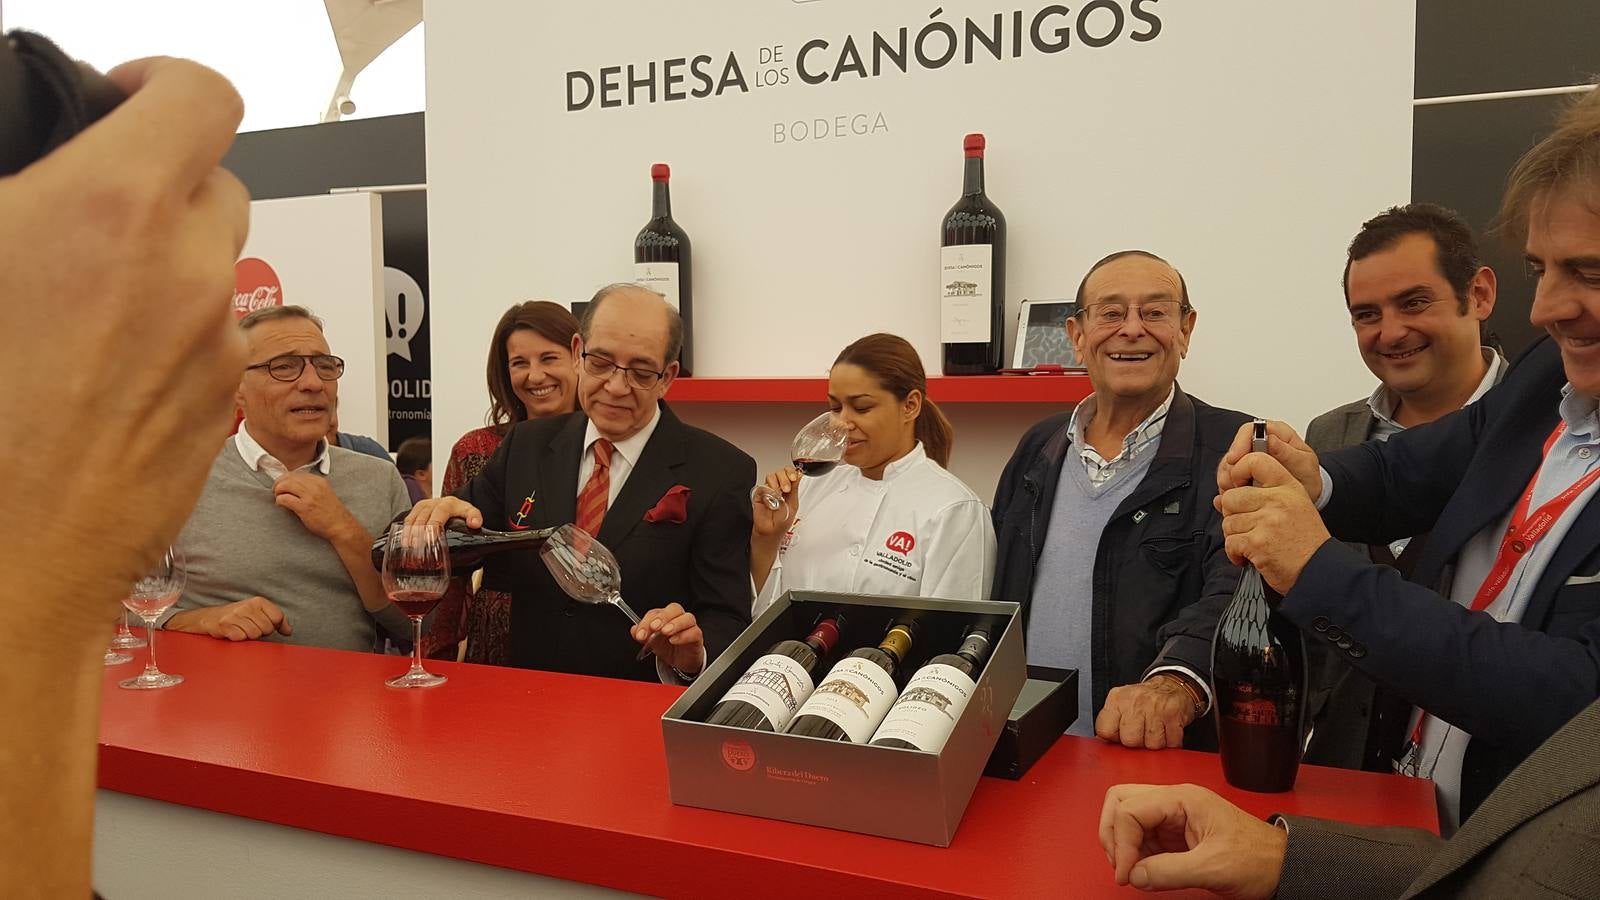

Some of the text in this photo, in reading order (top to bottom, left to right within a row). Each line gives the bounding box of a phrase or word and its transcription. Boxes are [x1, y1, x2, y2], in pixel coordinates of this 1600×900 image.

[796, 0, 1162, 84] CANÓNIGOS
[759, 45, 783, 64] DE
[566, 51, 749, 112] DEHESA
[755, 67, 789, 87] LOS
[773, 111, 888, 143] BODEGA
[1525, 513, 1553, 541] Valladolid
[889, 535, 911, 551] VA!
[876, 551, 912, 568] VALLADOLID
[926, 676, 968, 698] CANÓNIGOS
